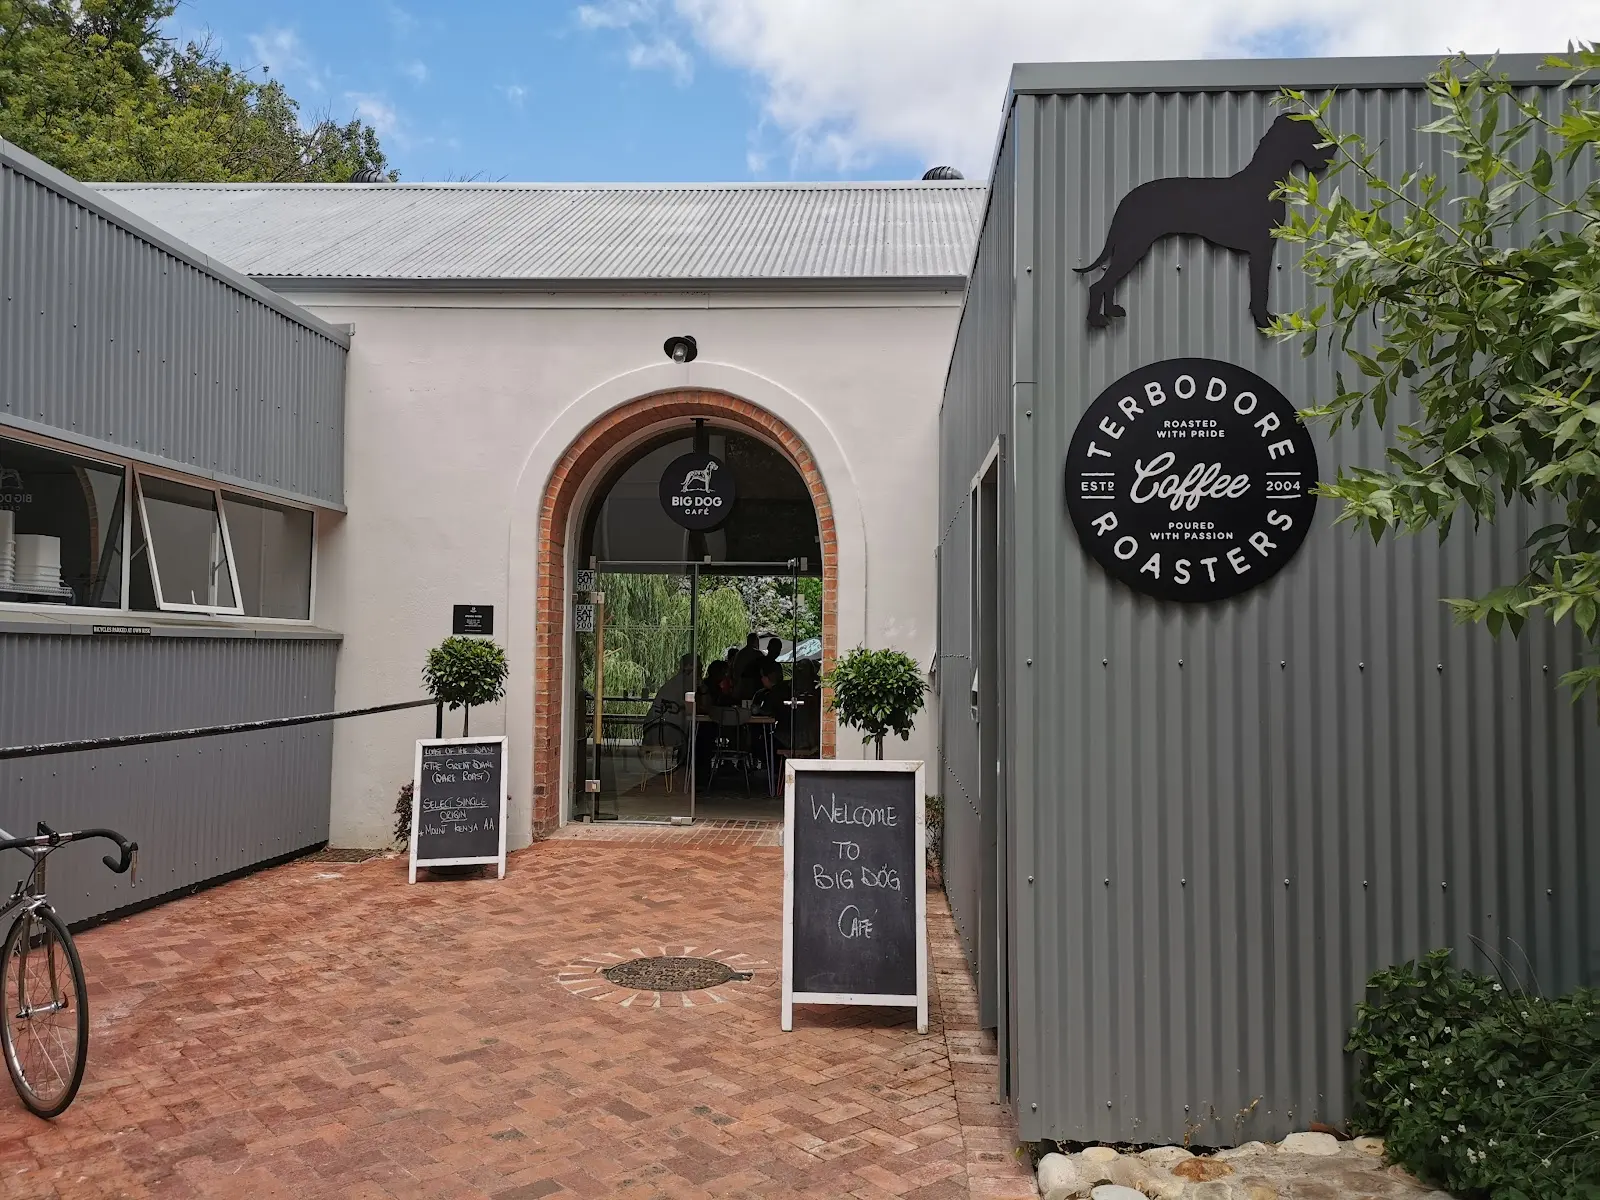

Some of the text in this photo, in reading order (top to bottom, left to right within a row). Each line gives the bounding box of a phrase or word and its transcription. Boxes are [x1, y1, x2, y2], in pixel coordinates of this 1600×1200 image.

[1086, 374, 1295, 460] TERBODORE
[1163, 419, 1217, 429] ROASTED
[1156, 430, 1226, 438] WITH PRIDE
[1130, 451, 1250, 511] Coffee
[1265, 480, 1301, 491] 2004
[671, 496, 723, 508] BIG DOG
[684, 507, 710, 515] CAFÉ
[1168, 521, 1215, 530] POURED
[1150, 532, 1234, 540] WITH PASSION
[1091, 509, 1293, 585] ROASTERS
[431, 771, 456, 785] (DARK
[422, 796, 488, 811] SELECT SINGLE
[811, 793, 898, 827] WELCOME
[483, 817, 495, 831] AA
[832, 841, 860, 860] TO
[813, 864, 854, 890] BIG
